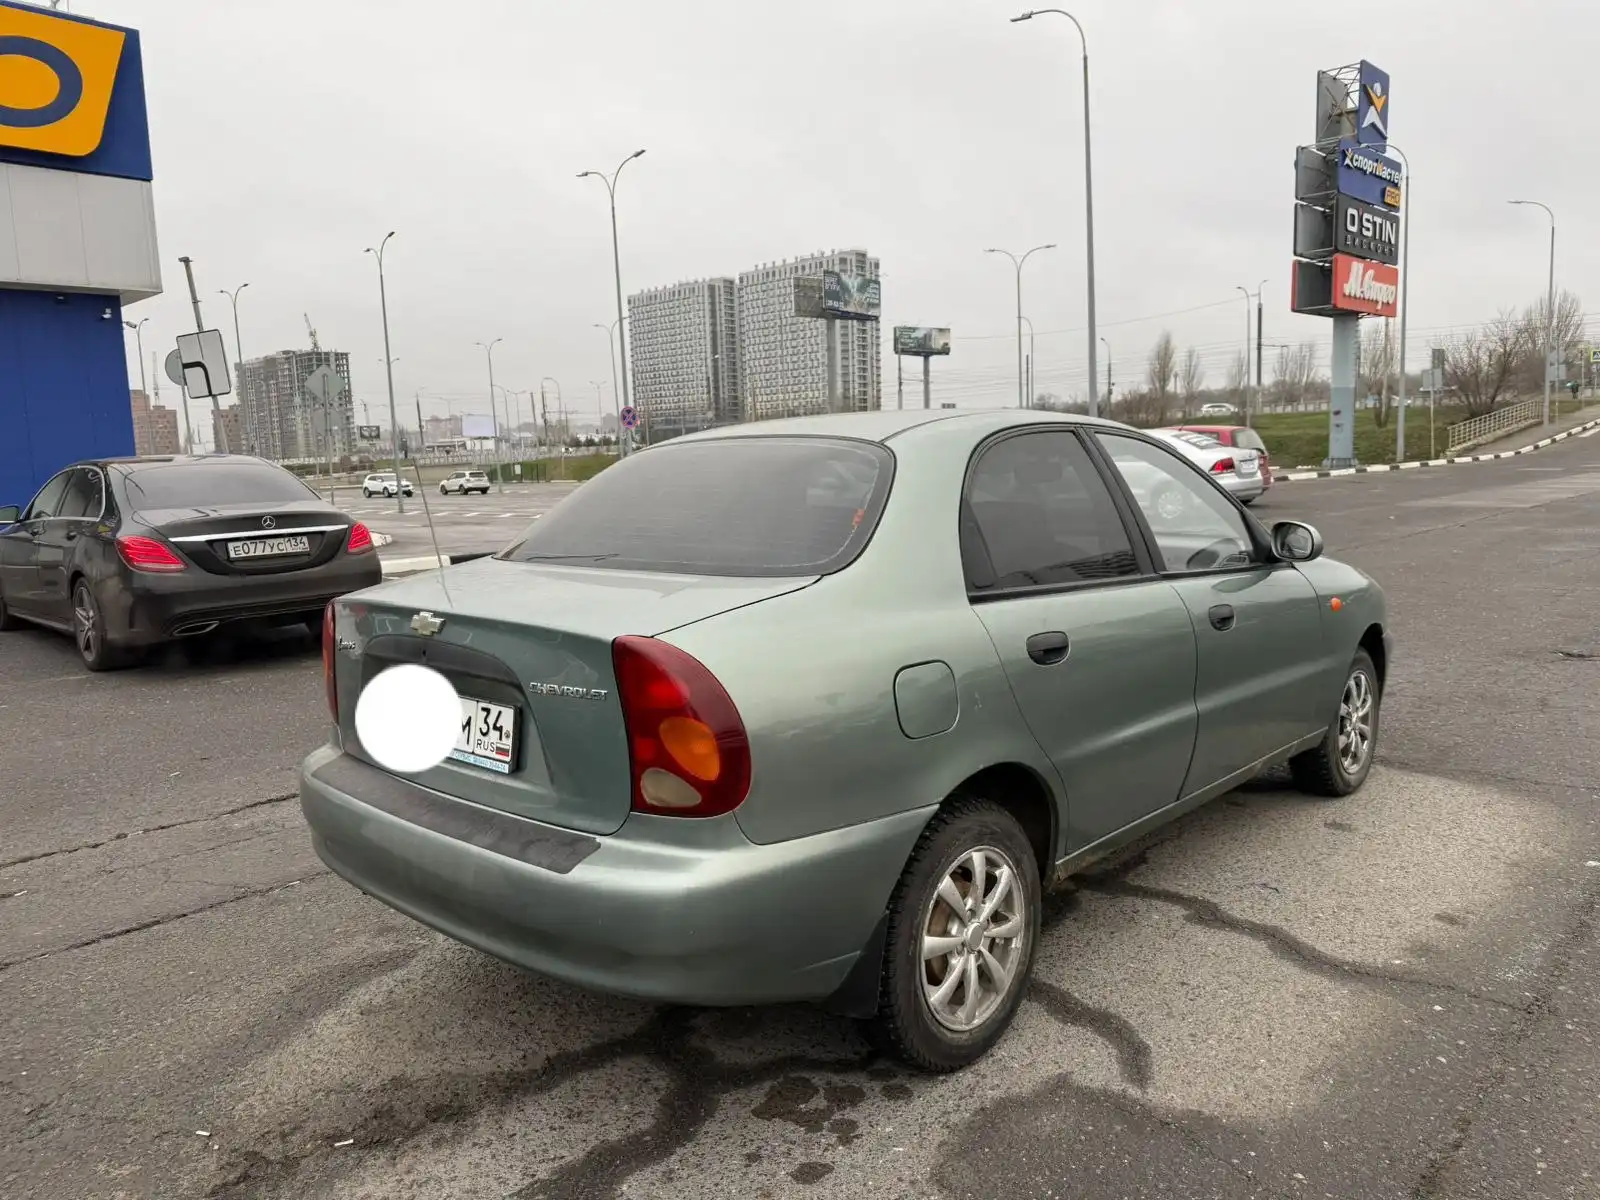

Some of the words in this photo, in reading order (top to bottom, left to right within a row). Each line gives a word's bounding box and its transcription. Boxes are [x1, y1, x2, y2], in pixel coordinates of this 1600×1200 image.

[1346, 207, 1396, 244] O'STIN
[529, 681, 608, 701] CHEVROLET
[479, 706, 504, 741] 34
[476, 738, 496, 753] RUS
